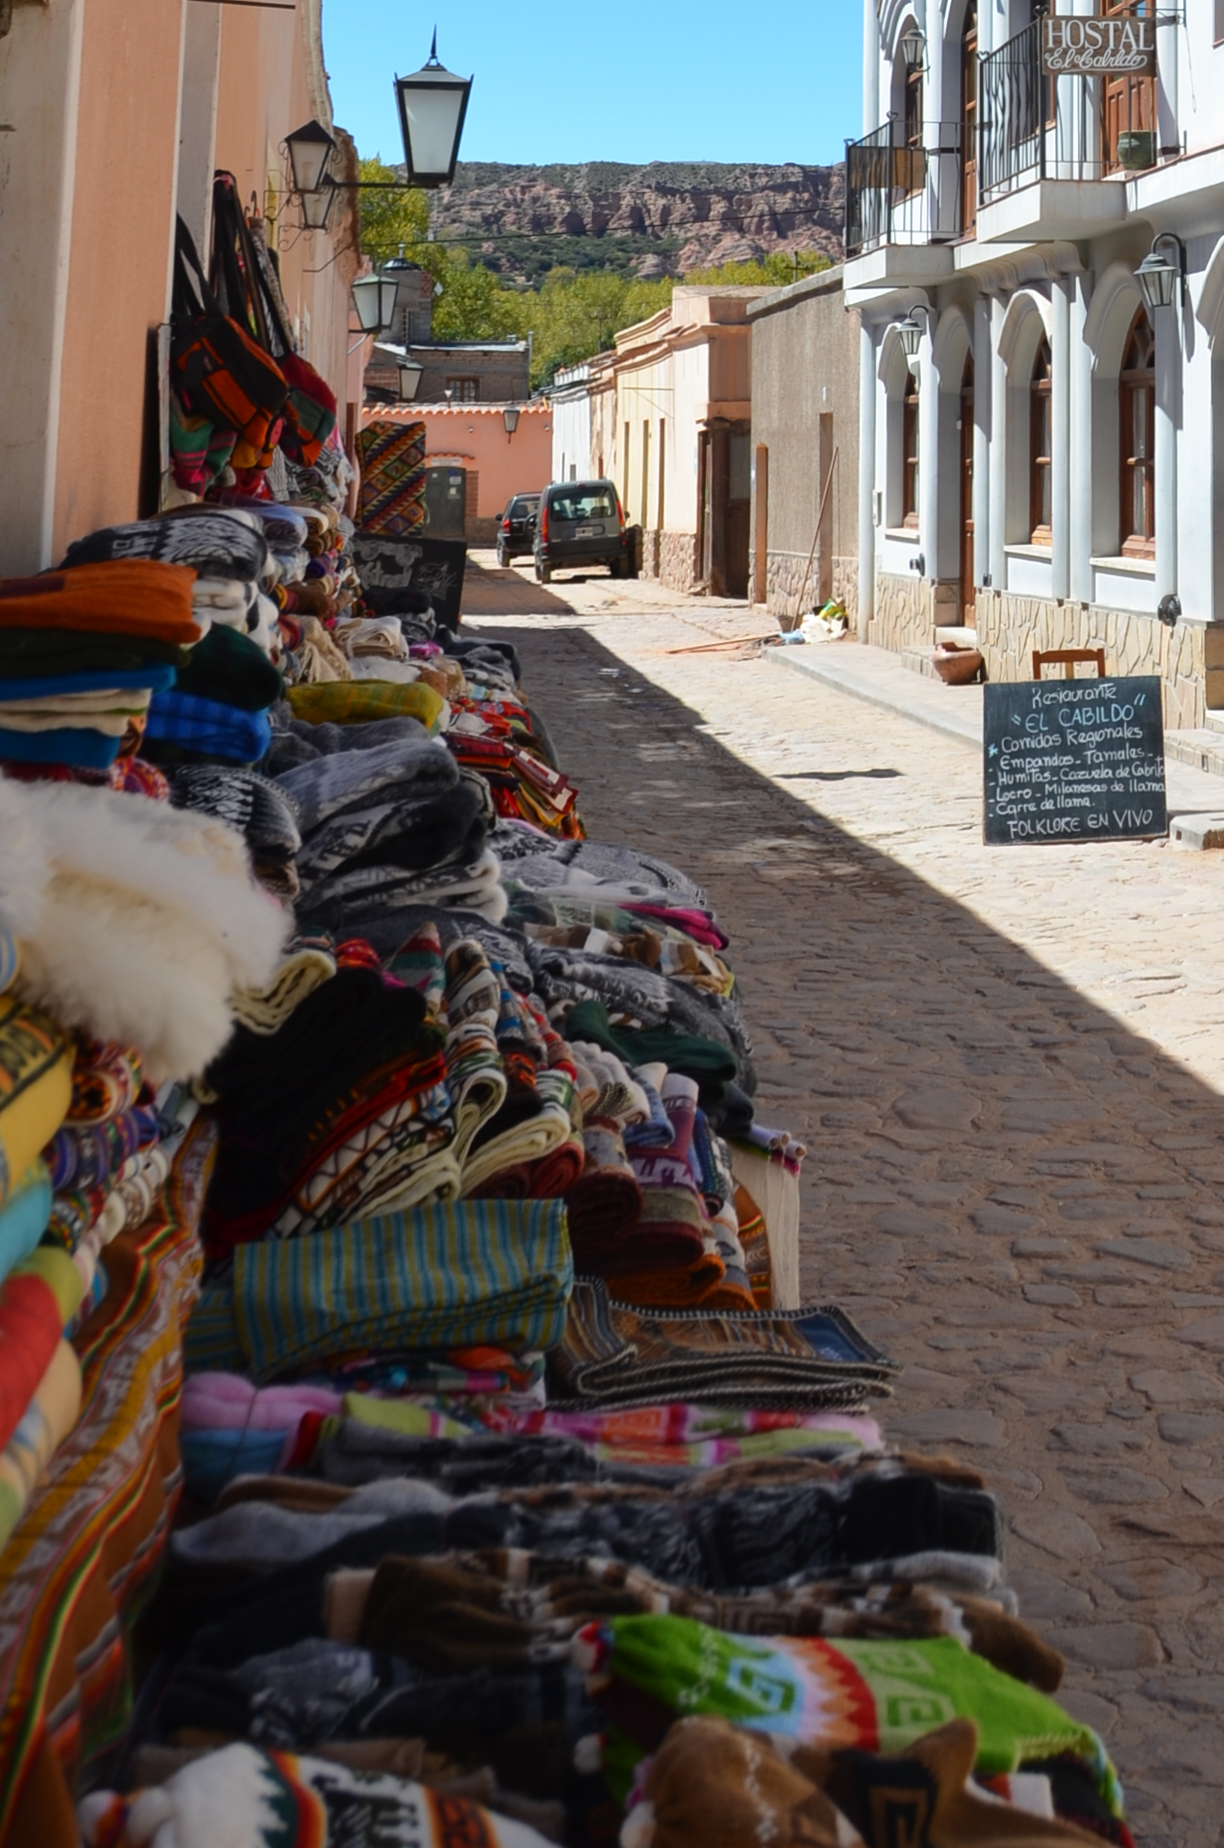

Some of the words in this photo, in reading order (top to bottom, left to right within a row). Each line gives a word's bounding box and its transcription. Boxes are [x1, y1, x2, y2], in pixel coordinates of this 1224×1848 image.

[1047, 20, 1154, 50] HOSTAL
[1045, 48, 1075, 69] El
[1074, 48, 1148, 69] Cabildo
[1032, 683, 1116, 709] Restaurante
[1001, 734, 1061, 753] Comidas
[1066, 722, 1143, 748] Regionales
[999, 768, 1051, 786] Humitas
[1060, 763, 1113, 780] Cazuela
[1116, 764, 1129, 778] de
[996, 787, 1032, 802] Locro
[1045, 782, 1107, 795] Milanesas
[1111, 782, 1125, 792] de
[1041, 800, 1055, 810] de
[1007, 817, 1081, 839] FOLKLORE
[1087, 814, 1108, 829] EN
[1113, 809, 1153, 828] VIVO
